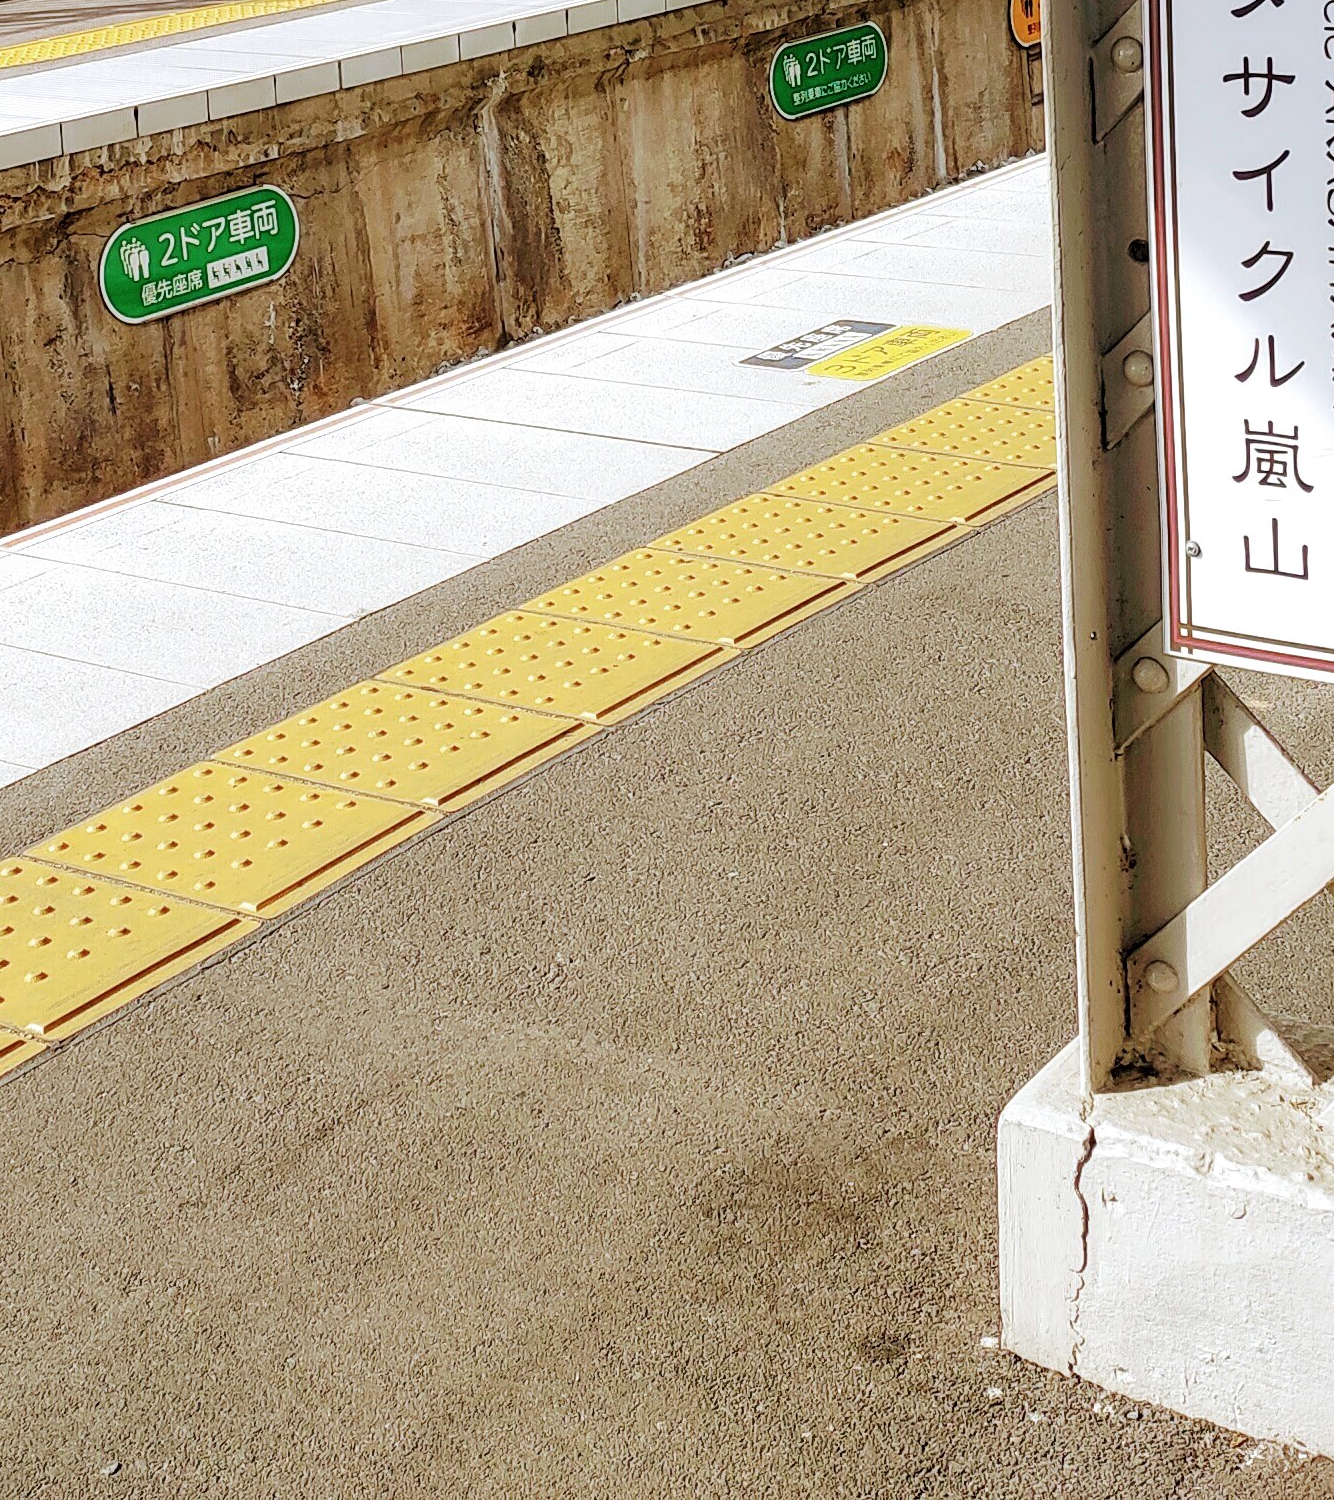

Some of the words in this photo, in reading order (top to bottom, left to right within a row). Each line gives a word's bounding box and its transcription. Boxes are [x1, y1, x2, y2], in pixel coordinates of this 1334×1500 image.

[805, 33, 877, 77] 2ドア車両
[157, 199, 279, 267] 2ドア車両
[141, 269, 203, 307] 優先座席
